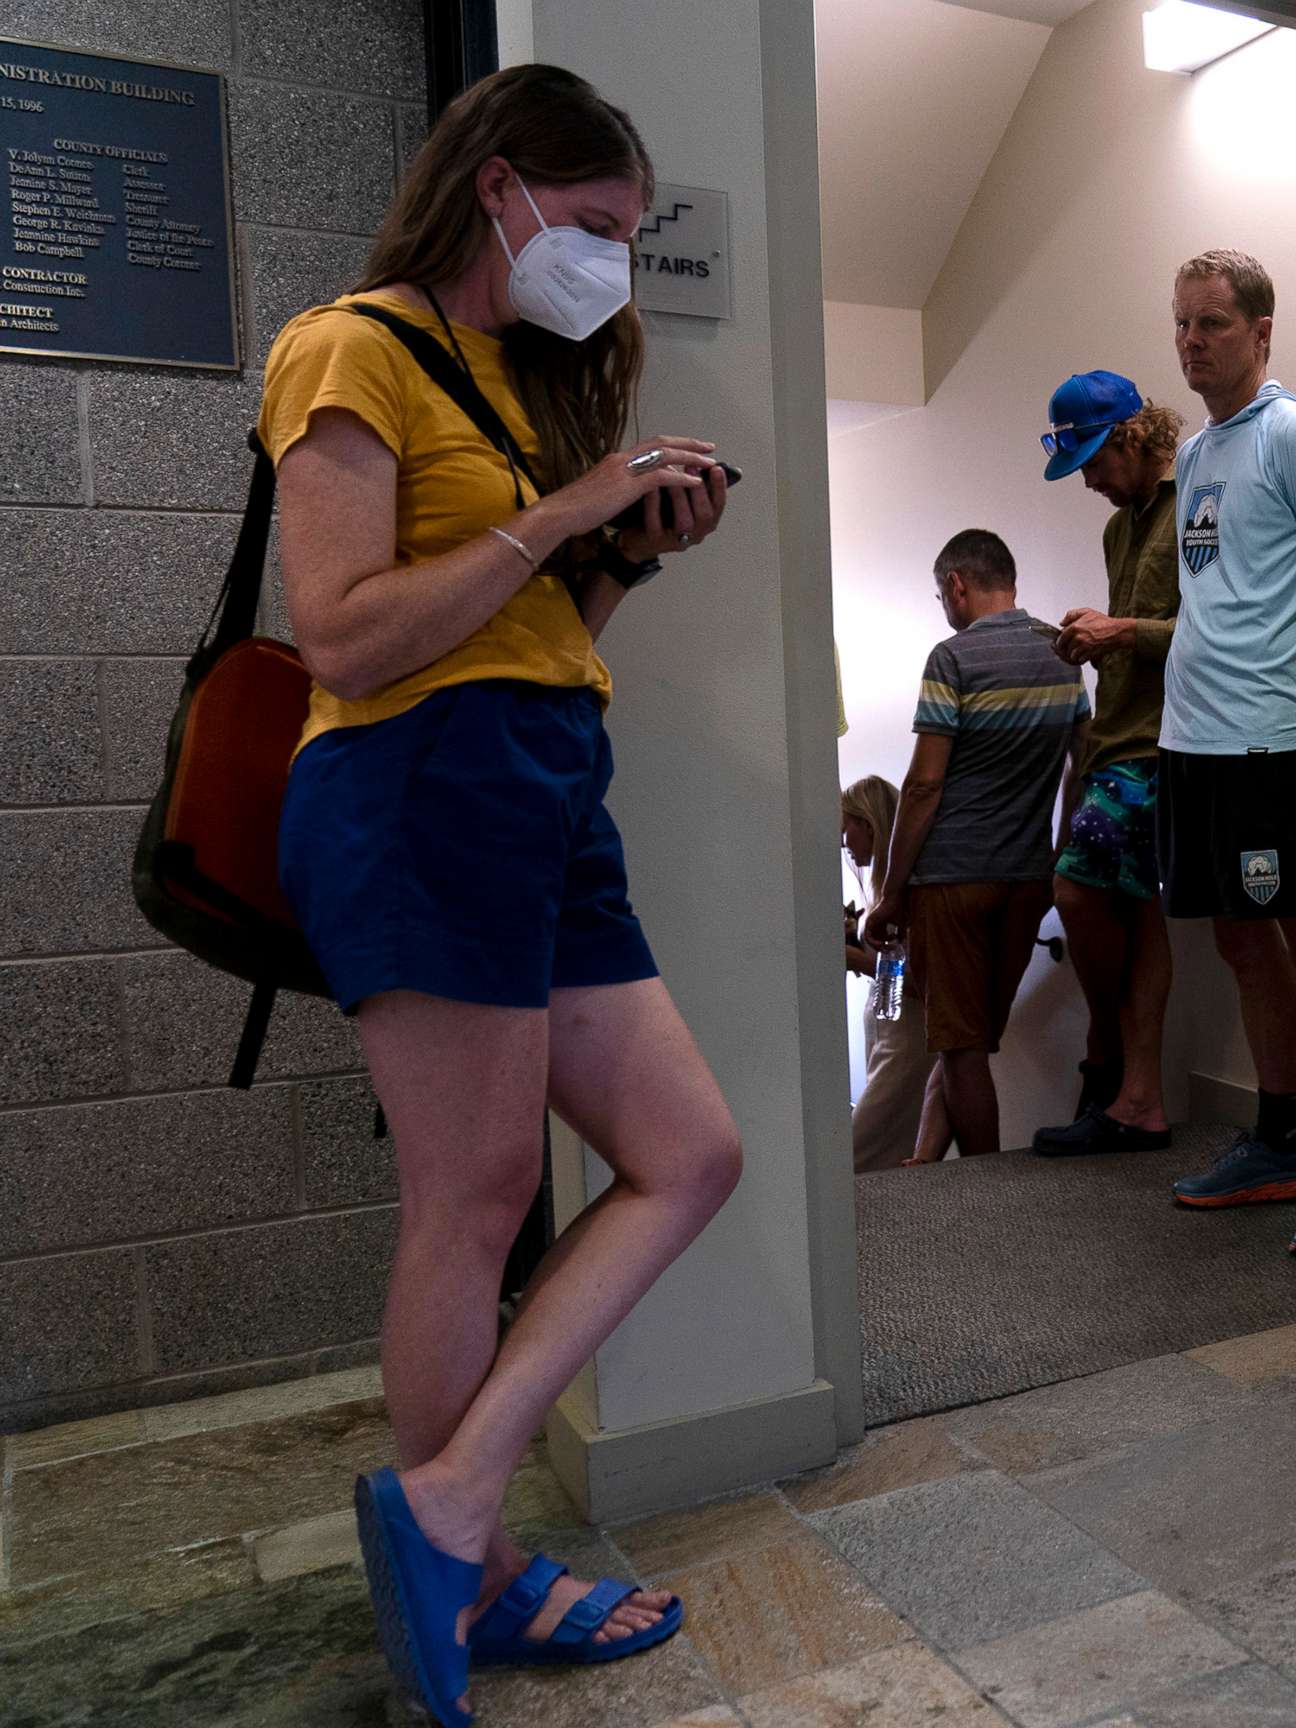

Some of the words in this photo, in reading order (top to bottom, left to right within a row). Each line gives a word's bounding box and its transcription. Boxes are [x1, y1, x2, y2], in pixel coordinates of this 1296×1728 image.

[111, 81, 196, 106] BUILDING
[18, 99, 46, 113] 1996
[54, 139, 102, 155] COUNTY
[105, 145, 168, 162] OFFICIALS
[10, 188, 41, 202] Roger
[12, 202, 51, 216] Stephen
[13, 215, 48, 229] George
[16, 241, 36, 253] Bob
[37, 243, 84, 258] Campbell
[2, 266, 87, 284] CONTRACTOR
[3, 280, 64, 295] Construction
[10, 319, 60, 332] Architects
